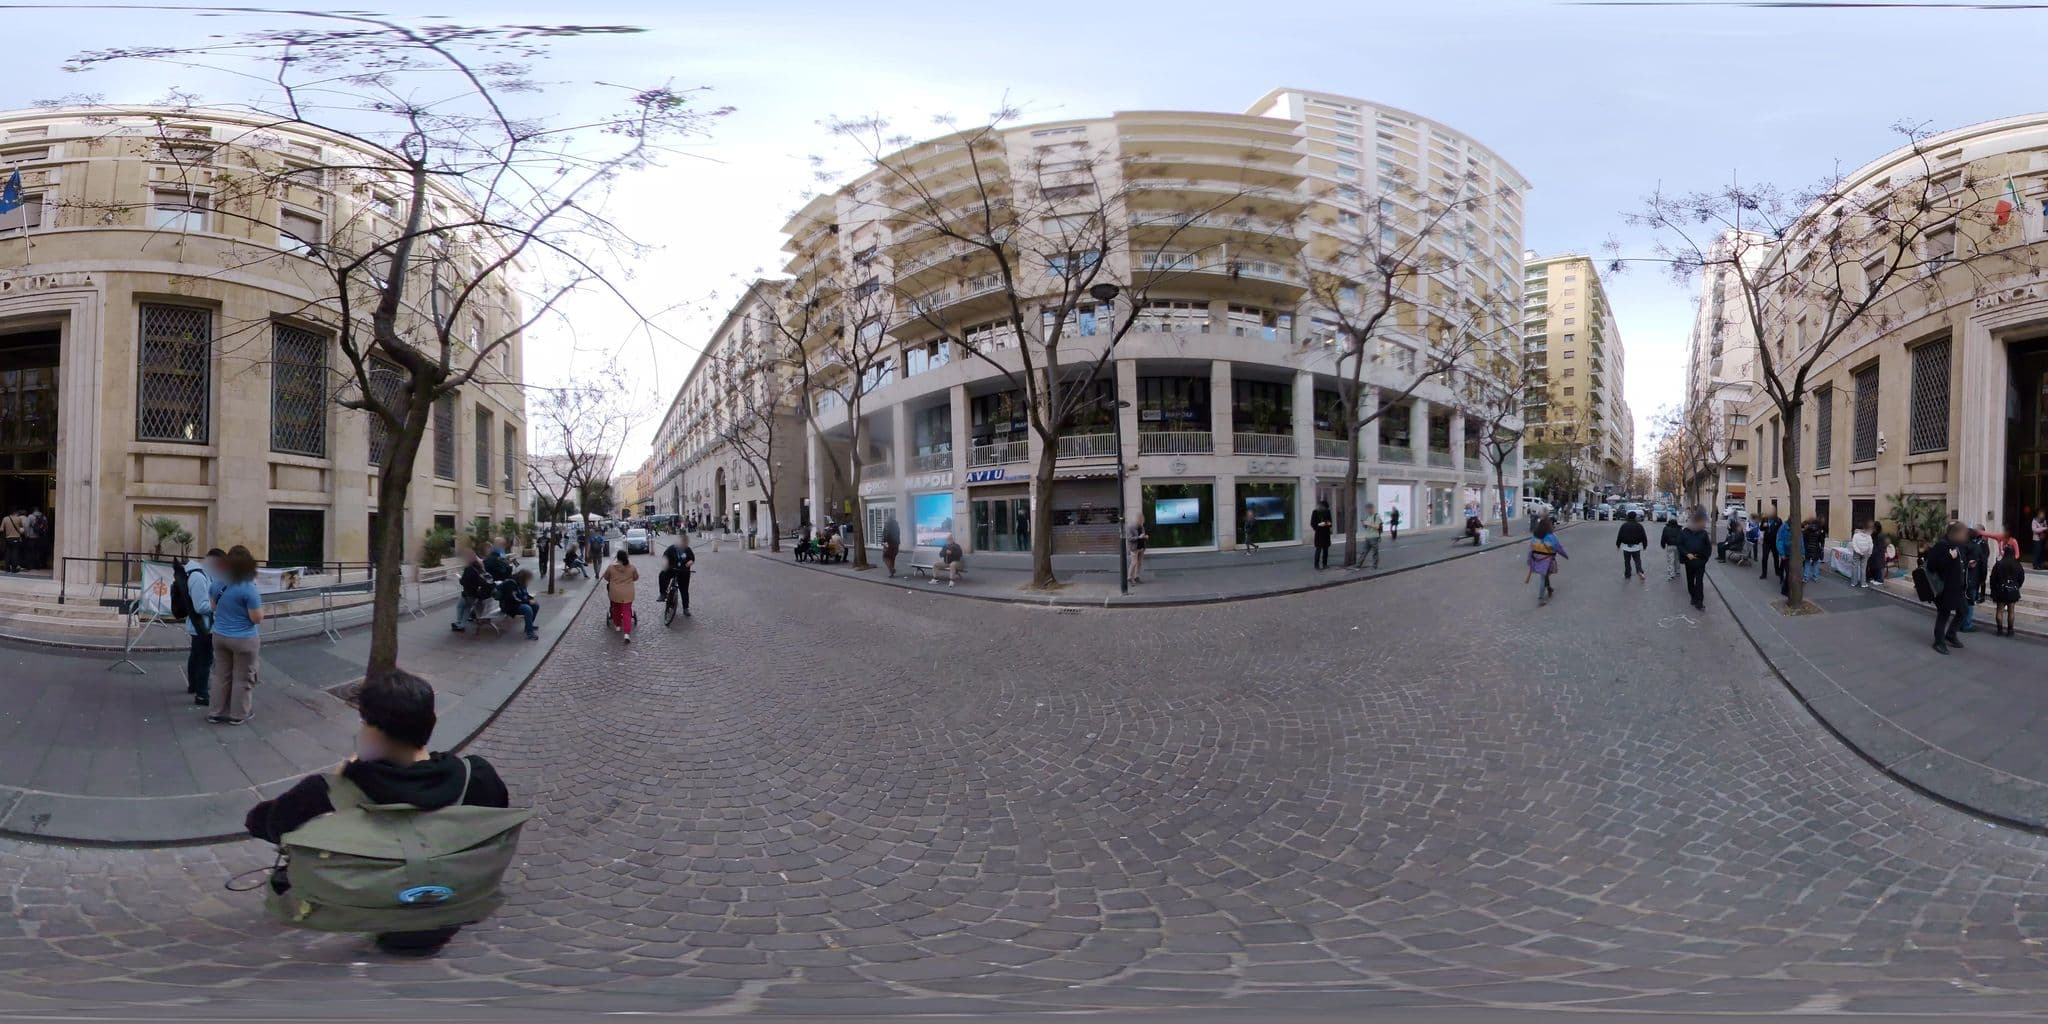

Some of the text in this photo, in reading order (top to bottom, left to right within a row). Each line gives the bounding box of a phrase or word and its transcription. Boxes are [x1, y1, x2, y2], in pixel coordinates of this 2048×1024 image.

[1975, 285, 2038, 310] BANCA
[1248, 460, 1289, 474] BCC
[904, 473, 953, 488] NAPOLI
